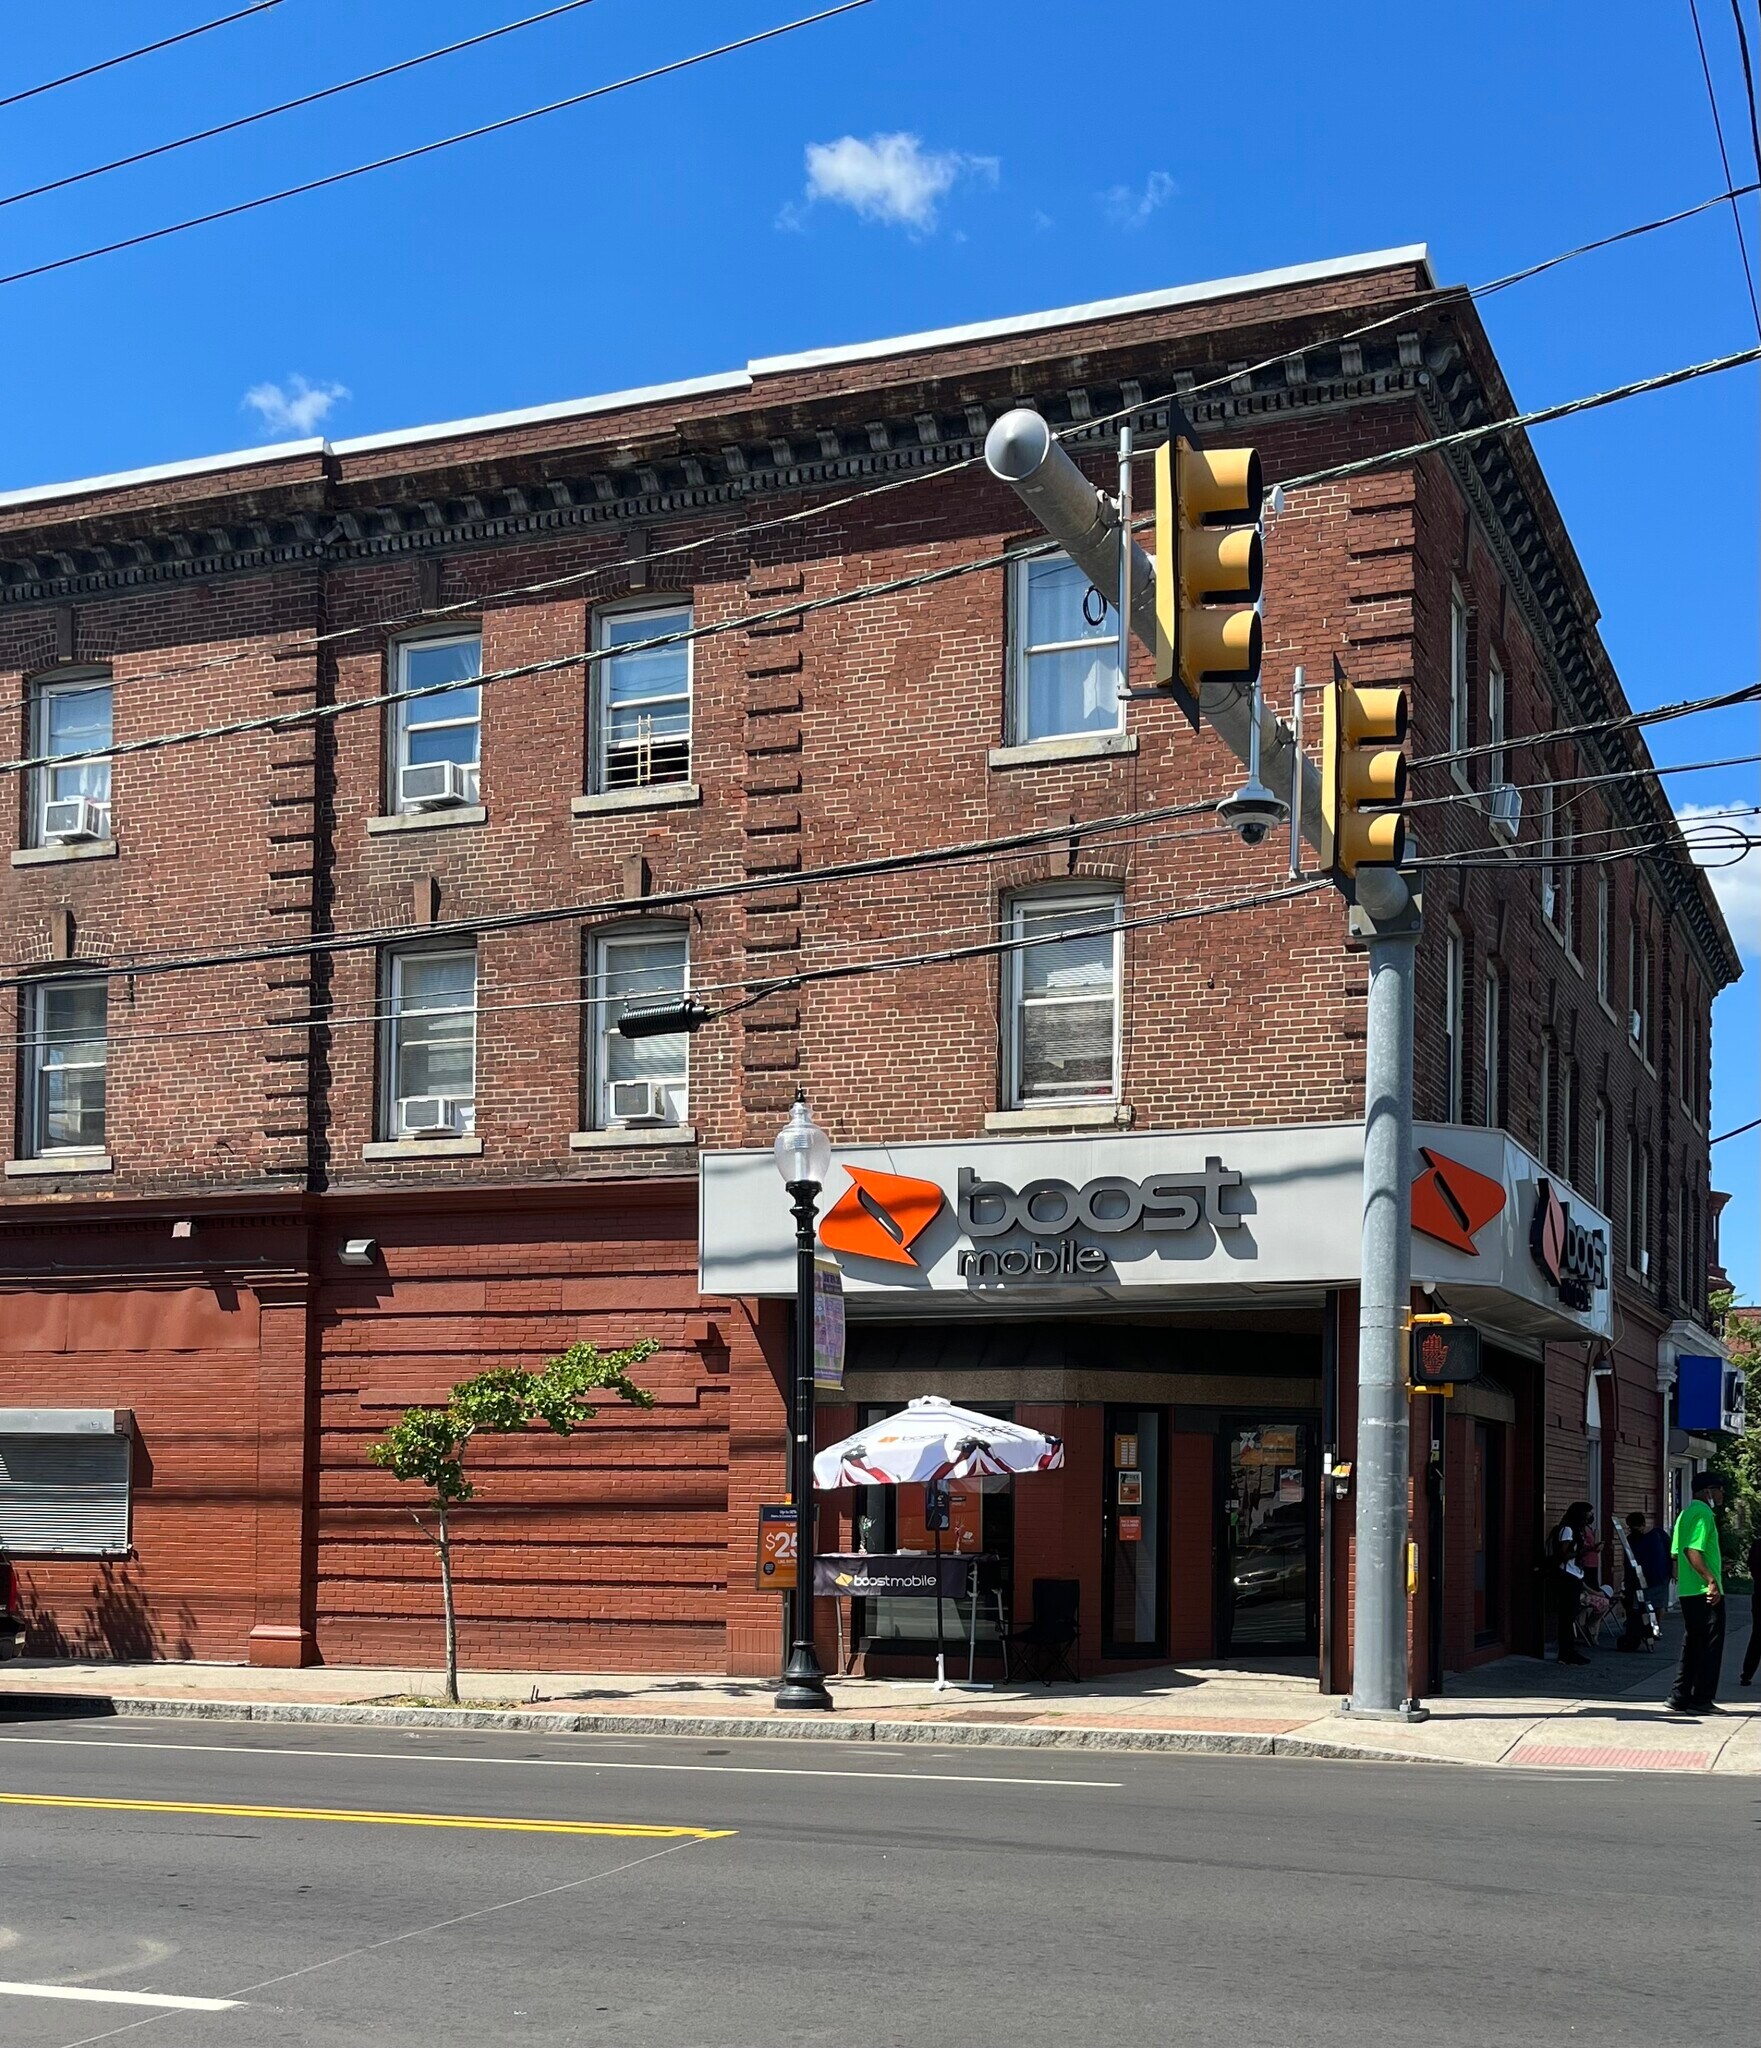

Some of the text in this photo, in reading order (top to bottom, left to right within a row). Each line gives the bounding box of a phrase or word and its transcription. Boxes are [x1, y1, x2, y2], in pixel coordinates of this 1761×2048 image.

[957, 1156, 1242, 1237] boost
[957, 1239, 1109, 1277] mobile
[1560, 1202, 1608, 1290] boost
